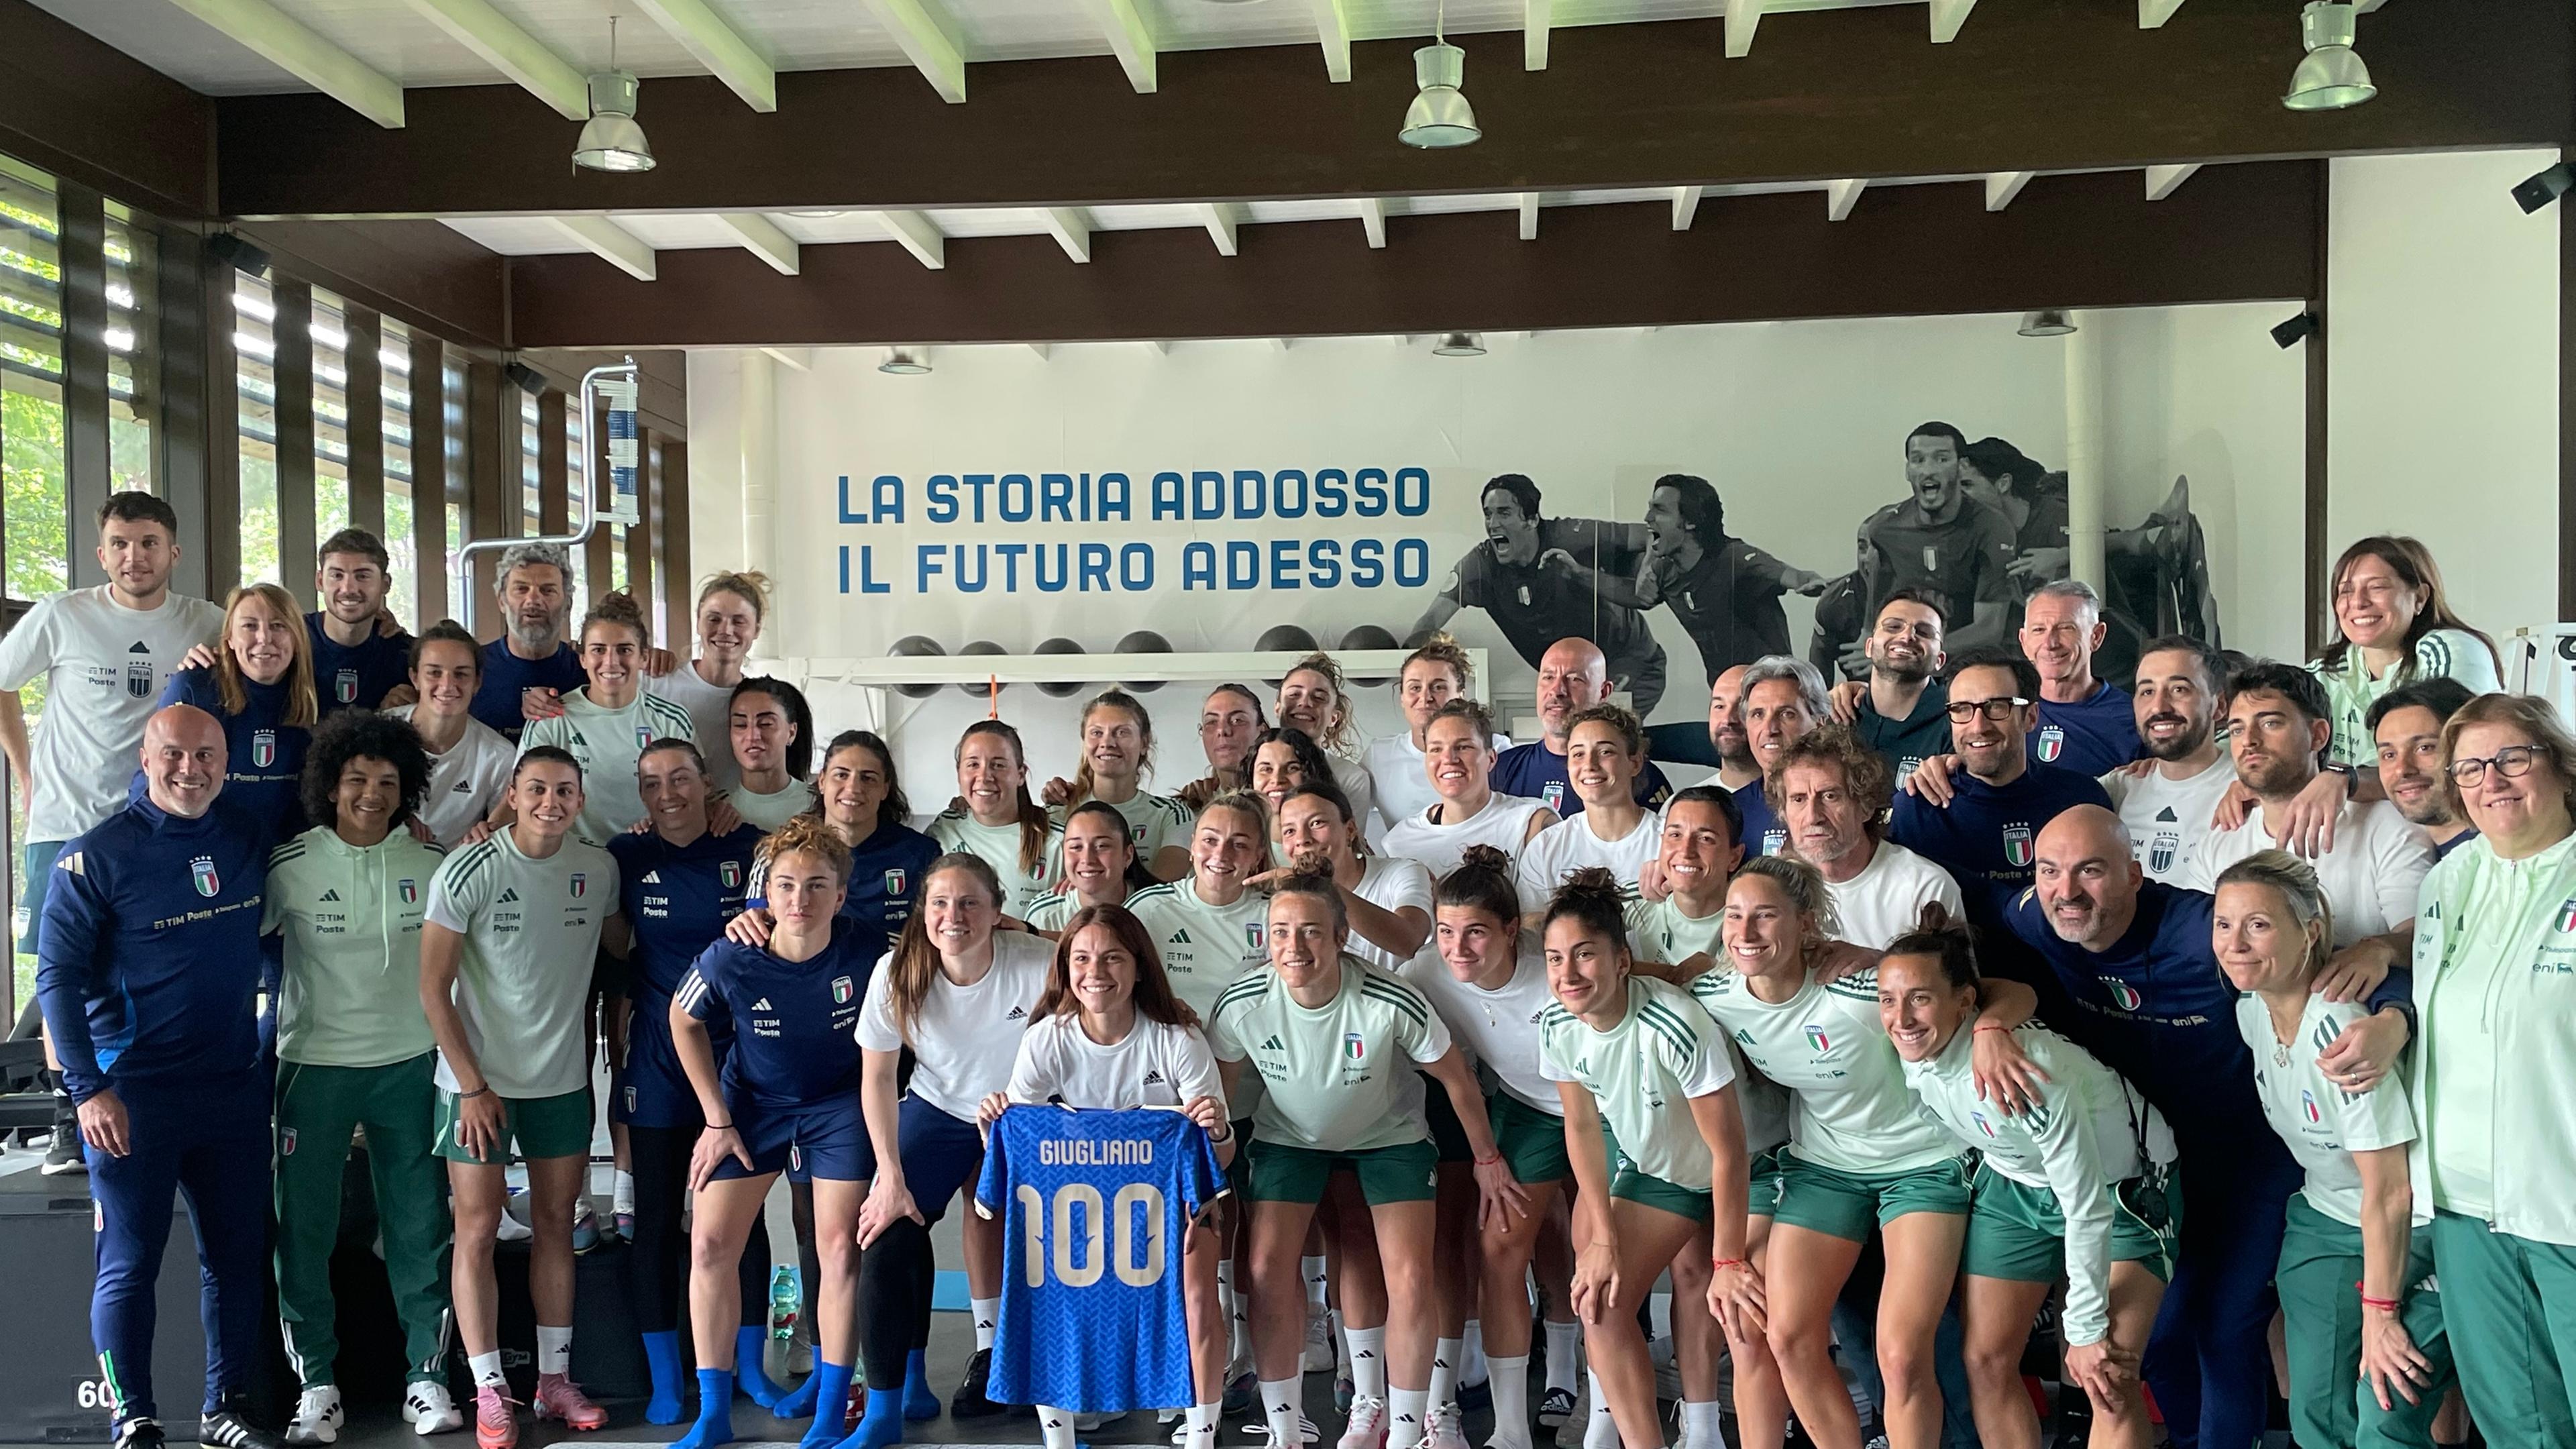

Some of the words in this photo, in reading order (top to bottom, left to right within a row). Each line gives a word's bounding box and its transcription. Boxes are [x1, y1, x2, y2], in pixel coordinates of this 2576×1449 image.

[839, 475, 904, 524] LA
[926, 473, 1131, 523] STORIA
[1152, 467, 1430, 521] ADDOSSO
[839, 545, 891, 594] IL
[918, 542, 1154, 594] FUTURO
[1183, 538, 1429, 591] ADESSO
[99, 667, 117, 676] TIM
[129, 669, 150, 677] ITALIA
[89, 677, 116, 686] Poste
[233, 773, 260, 782] Poste
[2005, 830, 2029, 841] ITALIA
[2153, 841, 2176, 849] ITALIA
[1989, 870, 2023, 879] Poste
[651, 897, 669, 906] TIM
[643, 906, 669, 917] Poste
[885, 912, 898, 920] eni
[166, 915, 185, 927] TIM
[186, 909, 213, 921] Poste
[327, 914, 346, 922] TIM
[504, 913, 521, 921] TIM
[316, 925, 345, 933] Poste
[494, 924, 520, 932] Poste
[1176, 953, 1193, 961] TIM
[1167, 963, 1193, 973] Poste
[2532, 963, 2556, 973] eni
[763, 1019, 780, 1027] TIM
[833, 1019, 847, 1030] eni
[2171, 1016, 2192, 1026] eni
[1269, 1062, 1287, 1073] TIM
[1815, 1071, 1833, 1080] eni
[1344, 1077, 1361, 1086] eni
[1040, 1139, 1152, 1165] GIUGLIANO
[1016, 1182, 1166, 1288] 100
